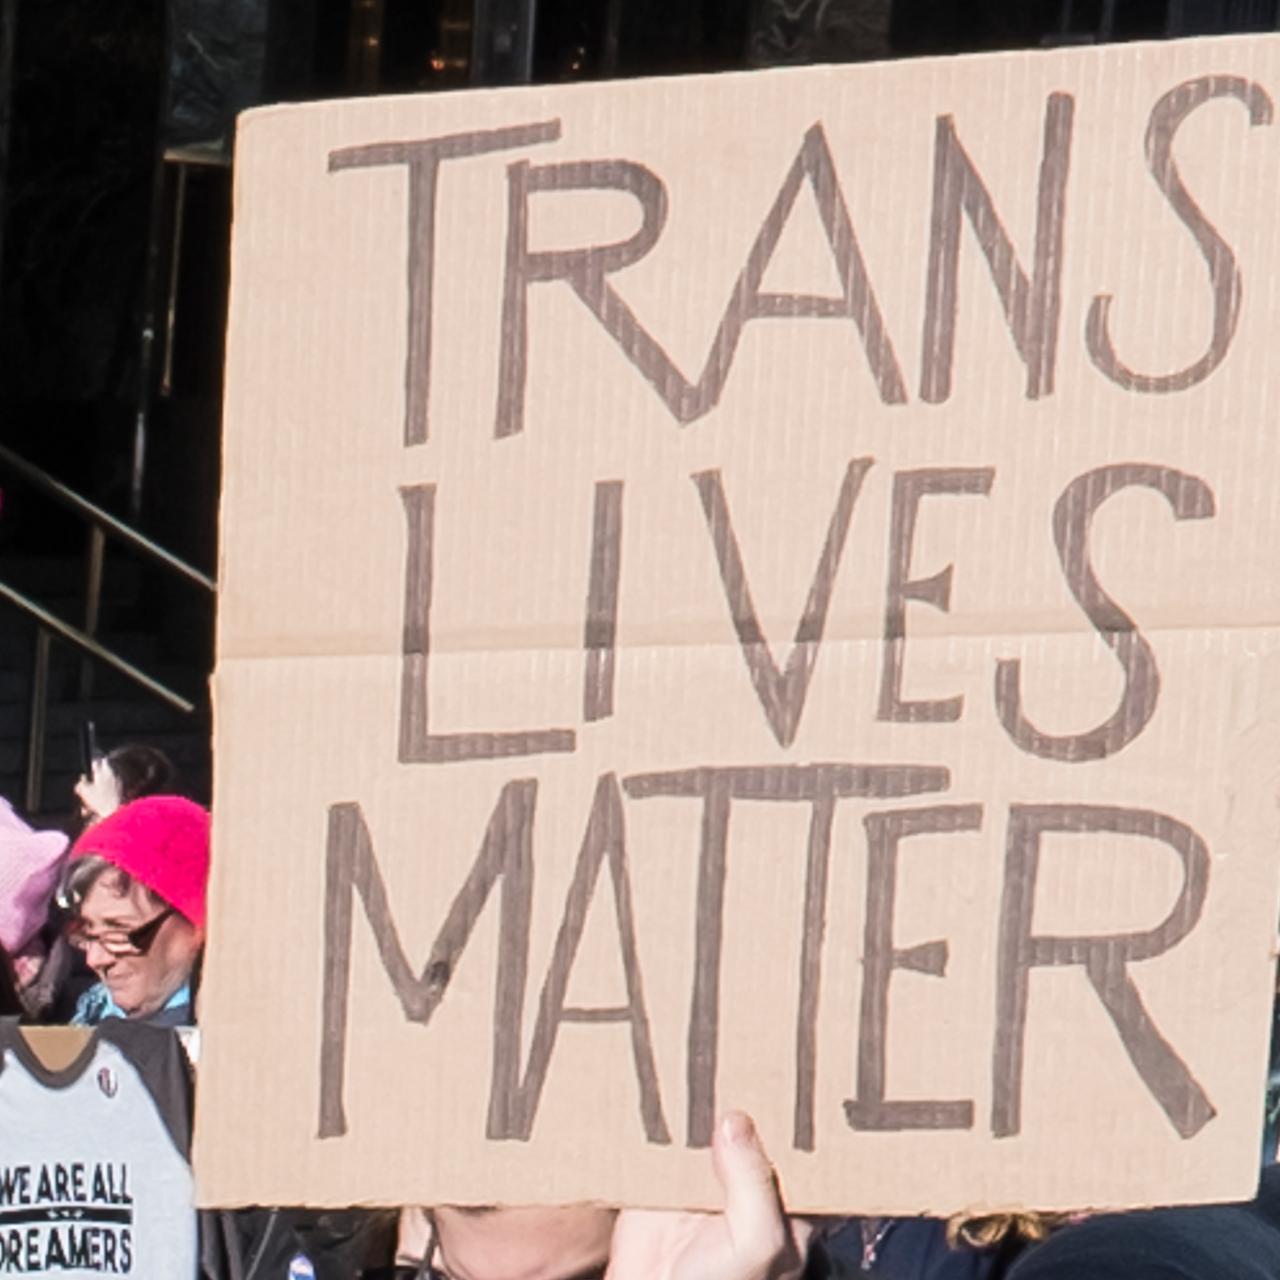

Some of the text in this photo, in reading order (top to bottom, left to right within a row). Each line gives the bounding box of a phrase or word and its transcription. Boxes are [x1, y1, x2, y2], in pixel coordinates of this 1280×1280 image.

[326, 72, 1276, 448] TRANS
[395, 455, 1218, 765] LIVES
[315, 762, 1219, 1154] MATTER
[35, 1163, 87, 1204] ARE
[92, 1162, 133, 1205] ALL
